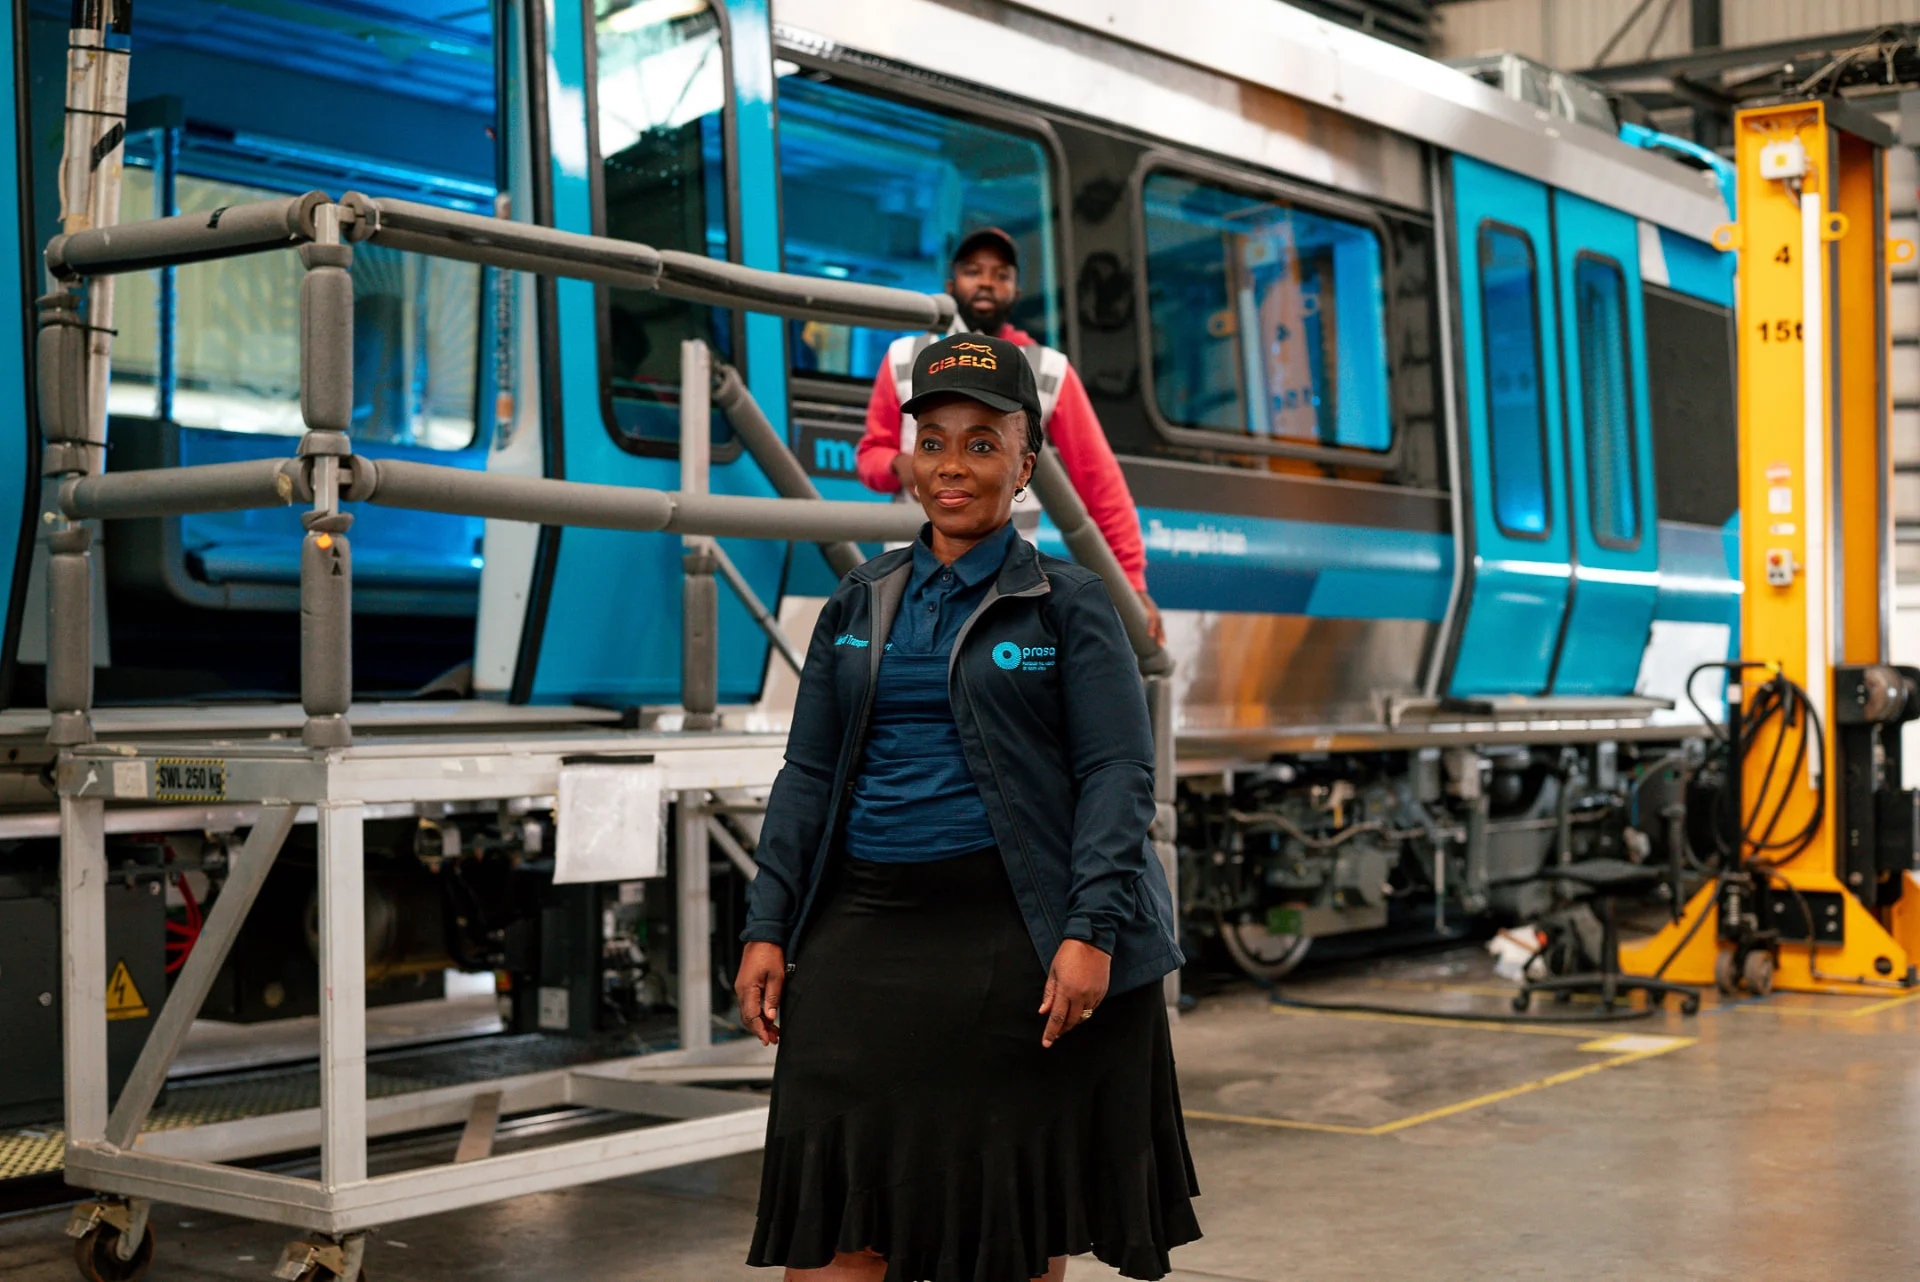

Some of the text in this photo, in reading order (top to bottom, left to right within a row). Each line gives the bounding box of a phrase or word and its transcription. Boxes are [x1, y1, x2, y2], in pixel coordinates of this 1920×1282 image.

[1775, 245, 1790, 264] 4
[1022, 647, 1056, 659] prasa
[160, 767, 183, 789] SWL
[185, 768, 206, 790] 250
[209, 768, 222, 794] kg
